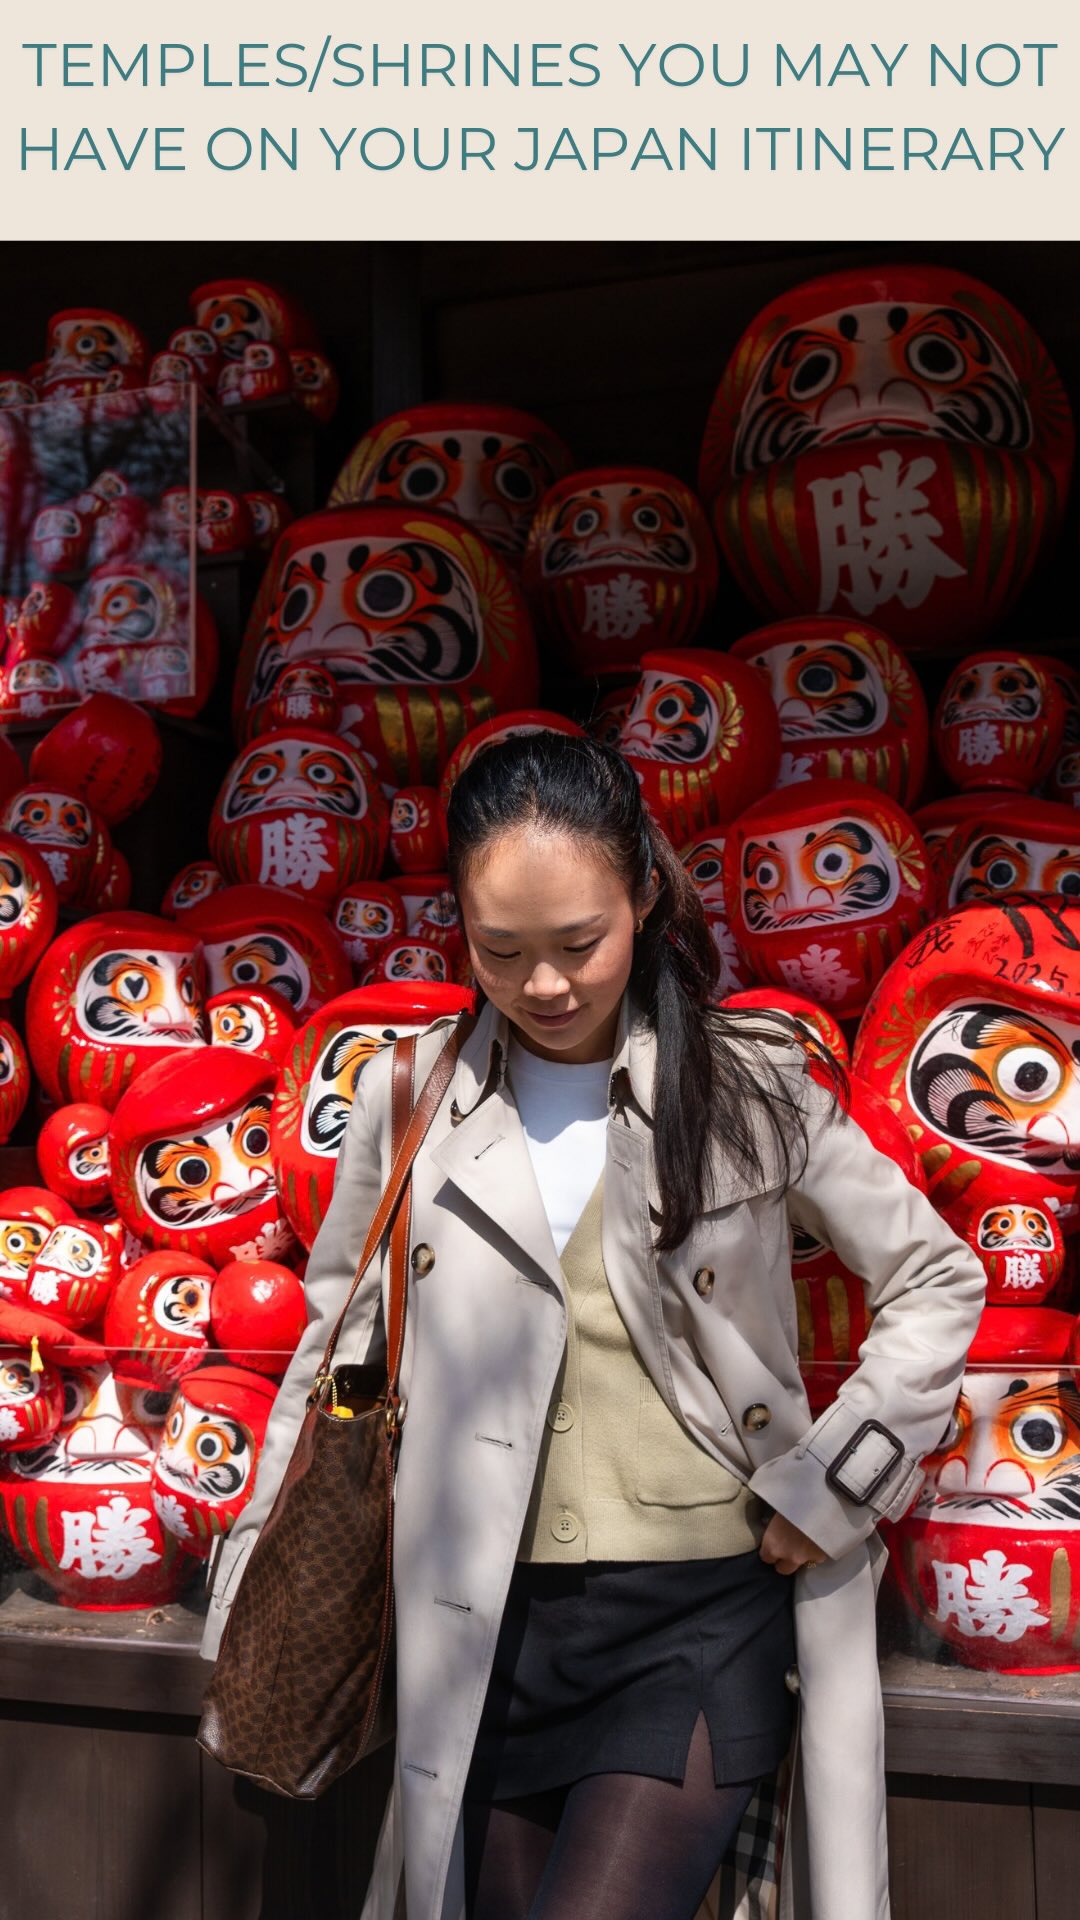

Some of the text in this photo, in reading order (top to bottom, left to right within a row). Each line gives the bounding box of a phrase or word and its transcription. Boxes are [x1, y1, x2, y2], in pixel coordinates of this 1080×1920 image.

[807, 449, 967, 614] 勝
[582, 573, 653, 640] 勝
[957, 721, 1004, 767] 勝
[259, 813, 334, 890] 勝
[777, 943, 861, 1003] 勝
[993, 957, 1068, 993] 2025
[1003, 1252, 1044, 1290] 勝
[59, 1497, 161, 1581] 勝
[931, 1550, 1050, 1644] 勝
